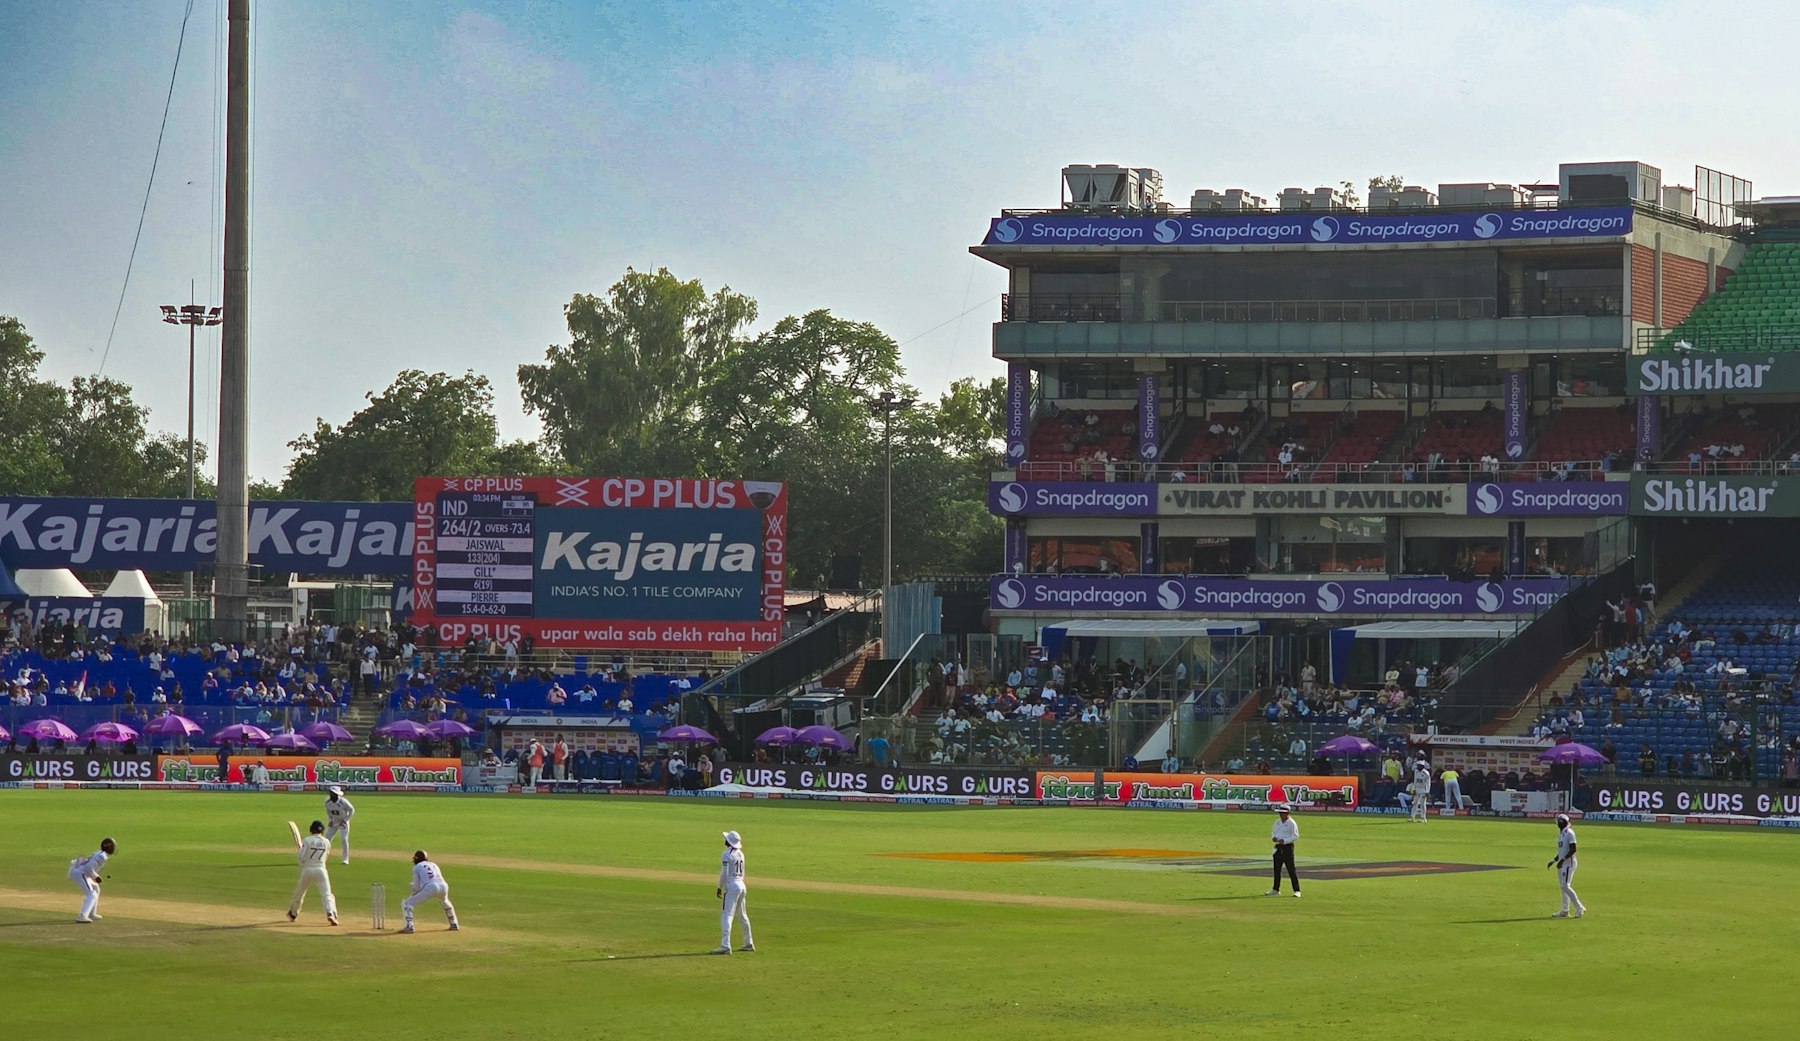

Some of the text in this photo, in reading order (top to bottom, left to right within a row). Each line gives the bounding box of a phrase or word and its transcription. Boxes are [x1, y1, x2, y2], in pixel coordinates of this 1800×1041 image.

[1031, 222, 1143, 241] Snapdragon
[1190, 222, 1301, 240] Snapdragon
[1347, 220, 1459, 238] Snapdragon
[1510, 214, 1624, 233] Snapdragon
[1011, 373, 1023, 436] Snapdragon
[1144, 377, 1155, 438] Snapdragon
[1509, 374, 1520, 437] Snapdragon
[464, 479, 524, 491] CP PLUS
[603, 479, 736, 509] CP PLUS
[442, 500, 468, 516] IND
[1036, 489, 1148, 510] Snapdragon
[1173, 490, 1443, 509] VIRAT KOHLI PAVILION
[1512, 489, 1623, 510] Snapdragon
[442, 520, 481, 536] 264/2
[485, 524, 509, 533] OVERS
[417, 502, 434, 586] CP PLUS
[466, 540, 506, 550] JAISWAL
[467, 553, 501, 565] 133(204)
[540, 532, 756, 581] Kajaria
[474, 580, 493, 590] 6(19)
[764, 539, 782, 621] CP PLUS
[471, 593, 499, 602] PIERRE
[551, 585, 743, 598] INDIA'S NO. 1 TILE COMPANY
[1034, 585, 1147, 606] Snapdragon
[1194, 587, 1306, 608] Snapdragon
[1353, 588, 1463, 609] Snapdragon
[462, 604, 506, 615] 15.4-0-62-0
[440, 624, 466, 641] CP
[541, 626, 777, 643] upar wala sab dekh raha hai
[9, 758, 75, 777] GAURS
[87, 757, 152, 777] GAURS
[391, 766, 457, 783] Vimal
[720, 766, 787, 786] GAURS
[800, 769, 868, 789] GAURS
[881, 771, 949, 793] GAURS
[962, 774, 1030, 794] GAURS
[1599, 788, 1664, 809] GAURS
[1677, 790, 1744, 811] GAURS
[310, 847, 325, 860] 77
